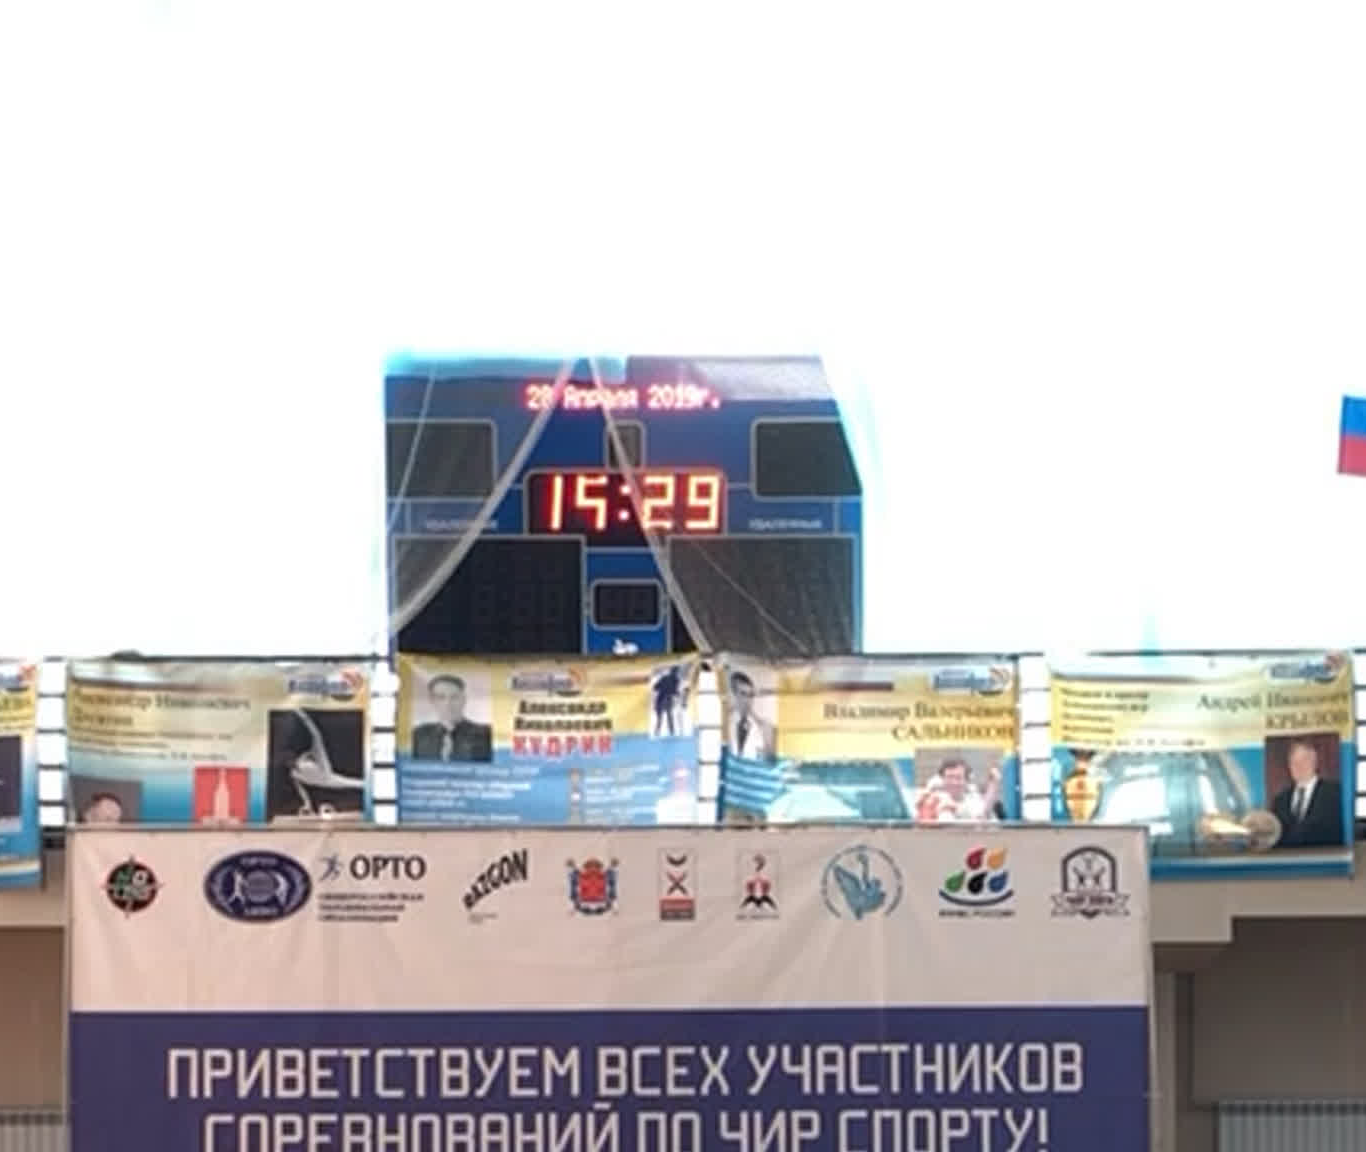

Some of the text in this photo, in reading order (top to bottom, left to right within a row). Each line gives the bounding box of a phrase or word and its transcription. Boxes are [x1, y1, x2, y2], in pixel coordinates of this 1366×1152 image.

[549, 473, 721, 531] 15:29
[518, 700, 607, 715] Александр
[823, 702, 911, 721] Владимир
[891, 725, 1014, 741] САЛЬНИКОВ
[512, 735, 613, 757] КУДРИН
[349, 853, 428, 881] ОРТО
[166, 1041, 1085, 1100] ПРИВЕТСТВУЕМ ВСЕХ УЧАСТНИКОВ
